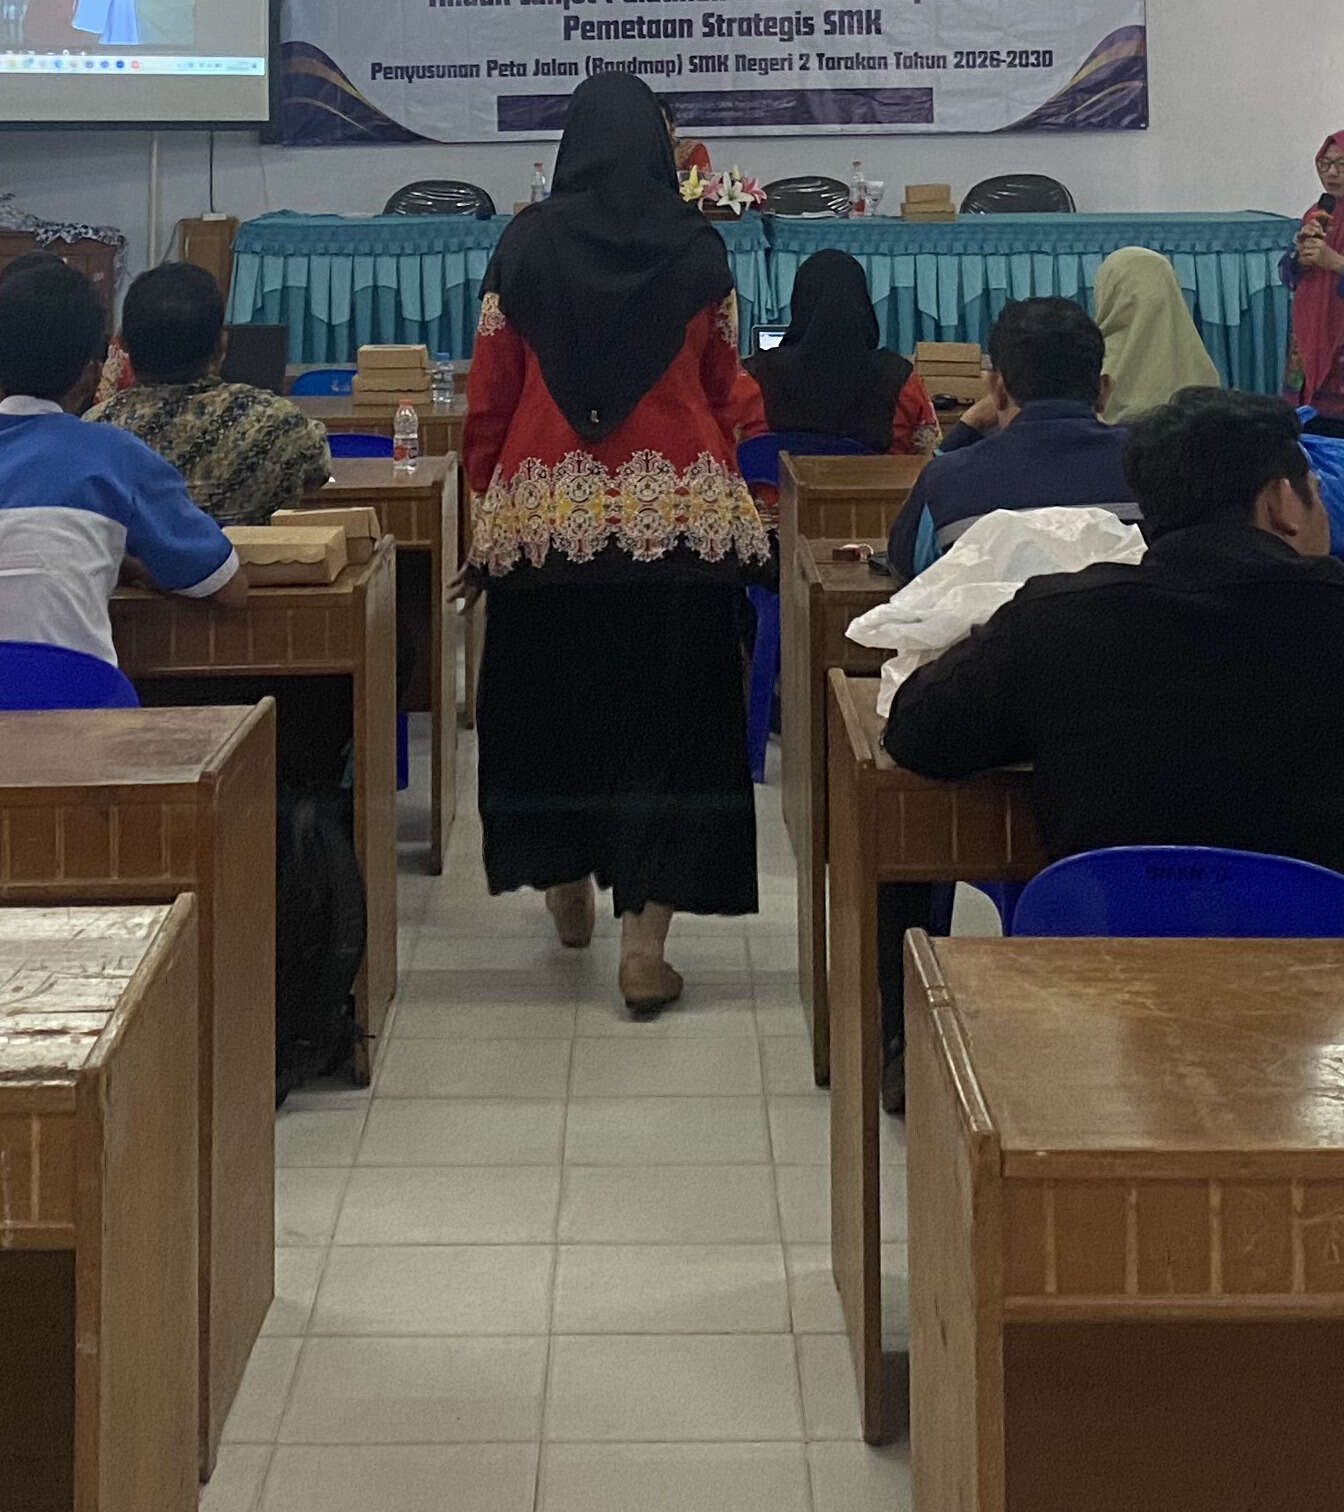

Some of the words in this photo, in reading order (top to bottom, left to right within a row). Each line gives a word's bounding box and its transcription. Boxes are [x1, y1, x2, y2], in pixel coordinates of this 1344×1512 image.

[563, 13, 693, 41] Pemetaan
[701, 10, 815, 43] Strategis
[823, 9, 883, 37] SMK
[370, 61, 481, 84] Penyusunan
[486, 59, 527, 78] Peta
[532, 57, 579, 77] Jalan
[688, 53, 729, 74] SMK
[734, 52, 793, 76] Negeri
[799, 53, 811, 72] 2
[816, 51, 888, 72] Tarakan
[893, 51, 947, 71] Tahun
[953, 49, 1054, 70] 2026-2030
